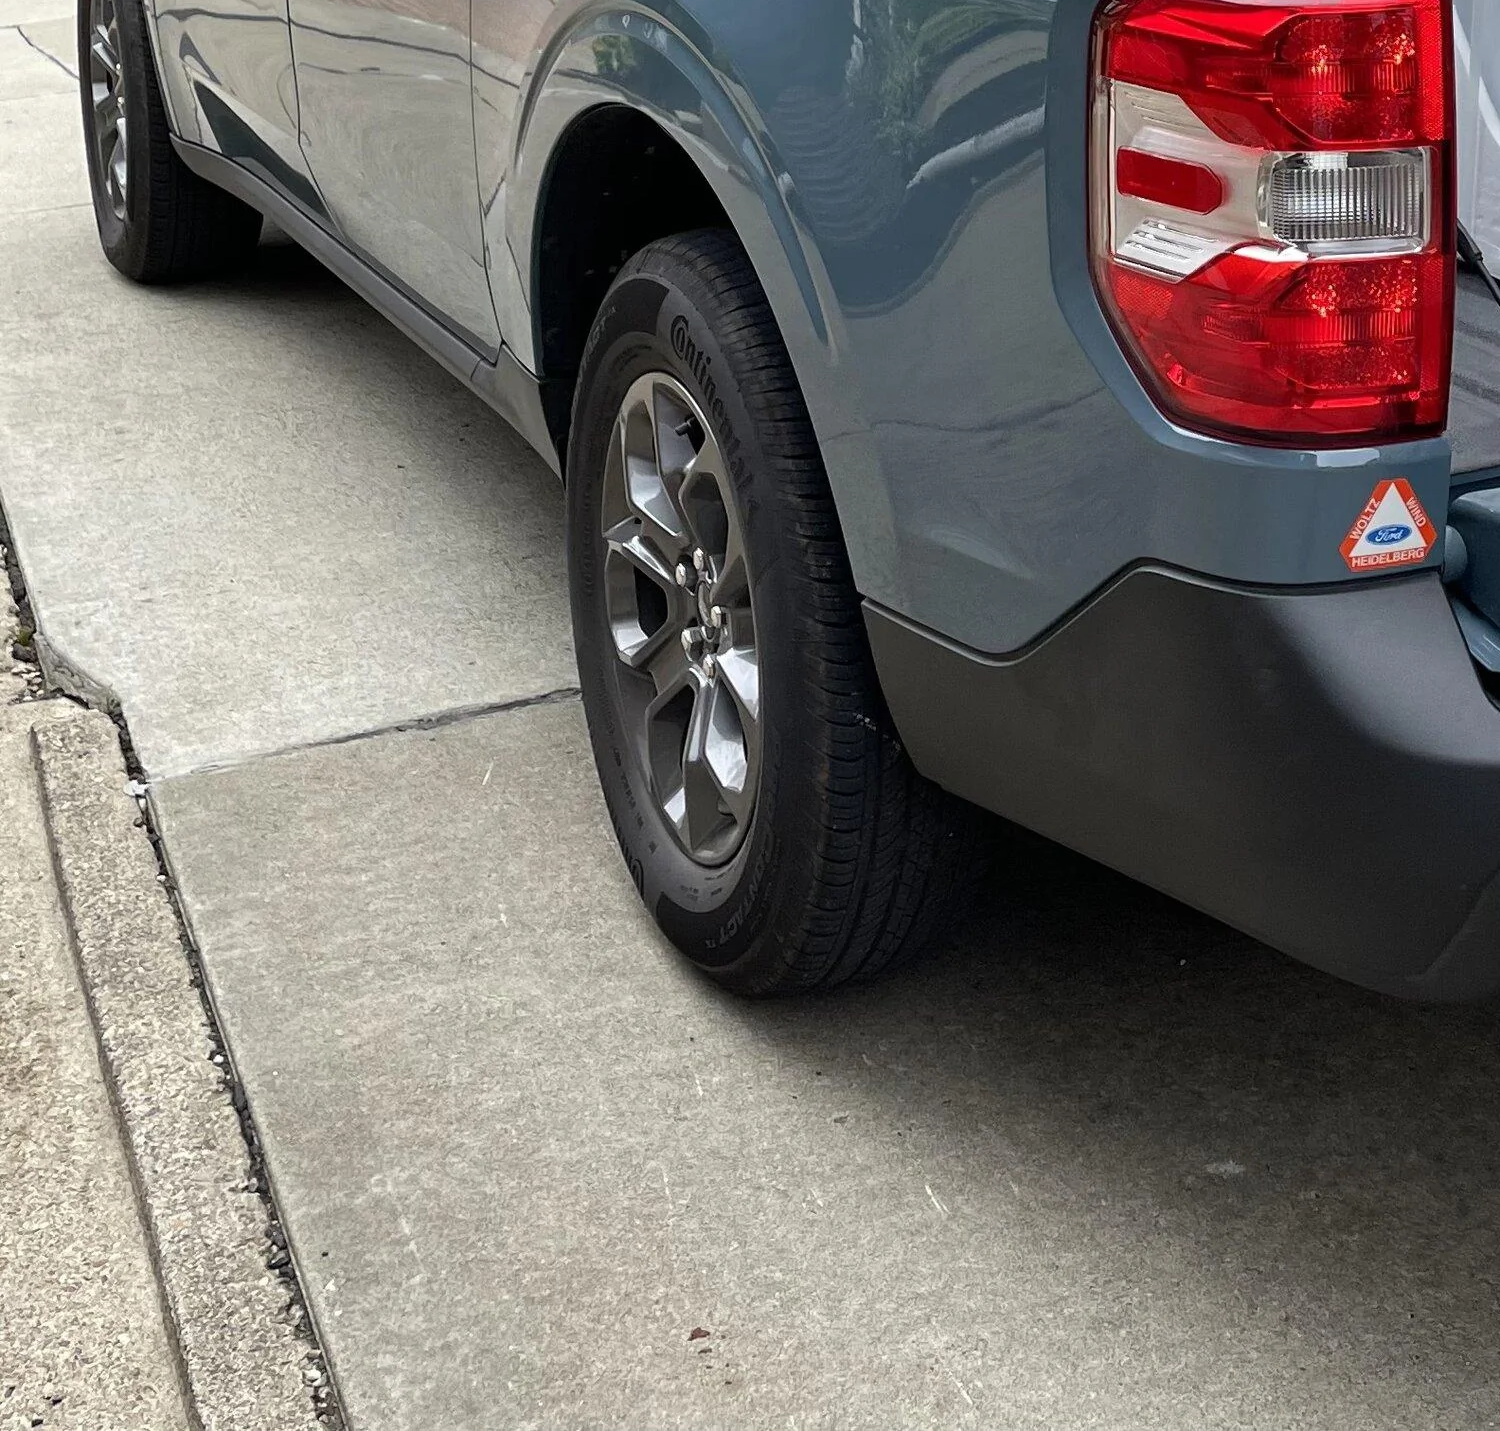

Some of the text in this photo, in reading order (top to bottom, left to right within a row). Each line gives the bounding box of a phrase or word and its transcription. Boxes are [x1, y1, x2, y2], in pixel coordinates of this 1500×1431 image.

[1350, 497, 1381, 541] WOLTZ
[1405, 496, 1427, 528] WIND
[1375, 527, 1403, 542] Ford
[1351, 547, 1426, 568] HEIDELBERG
